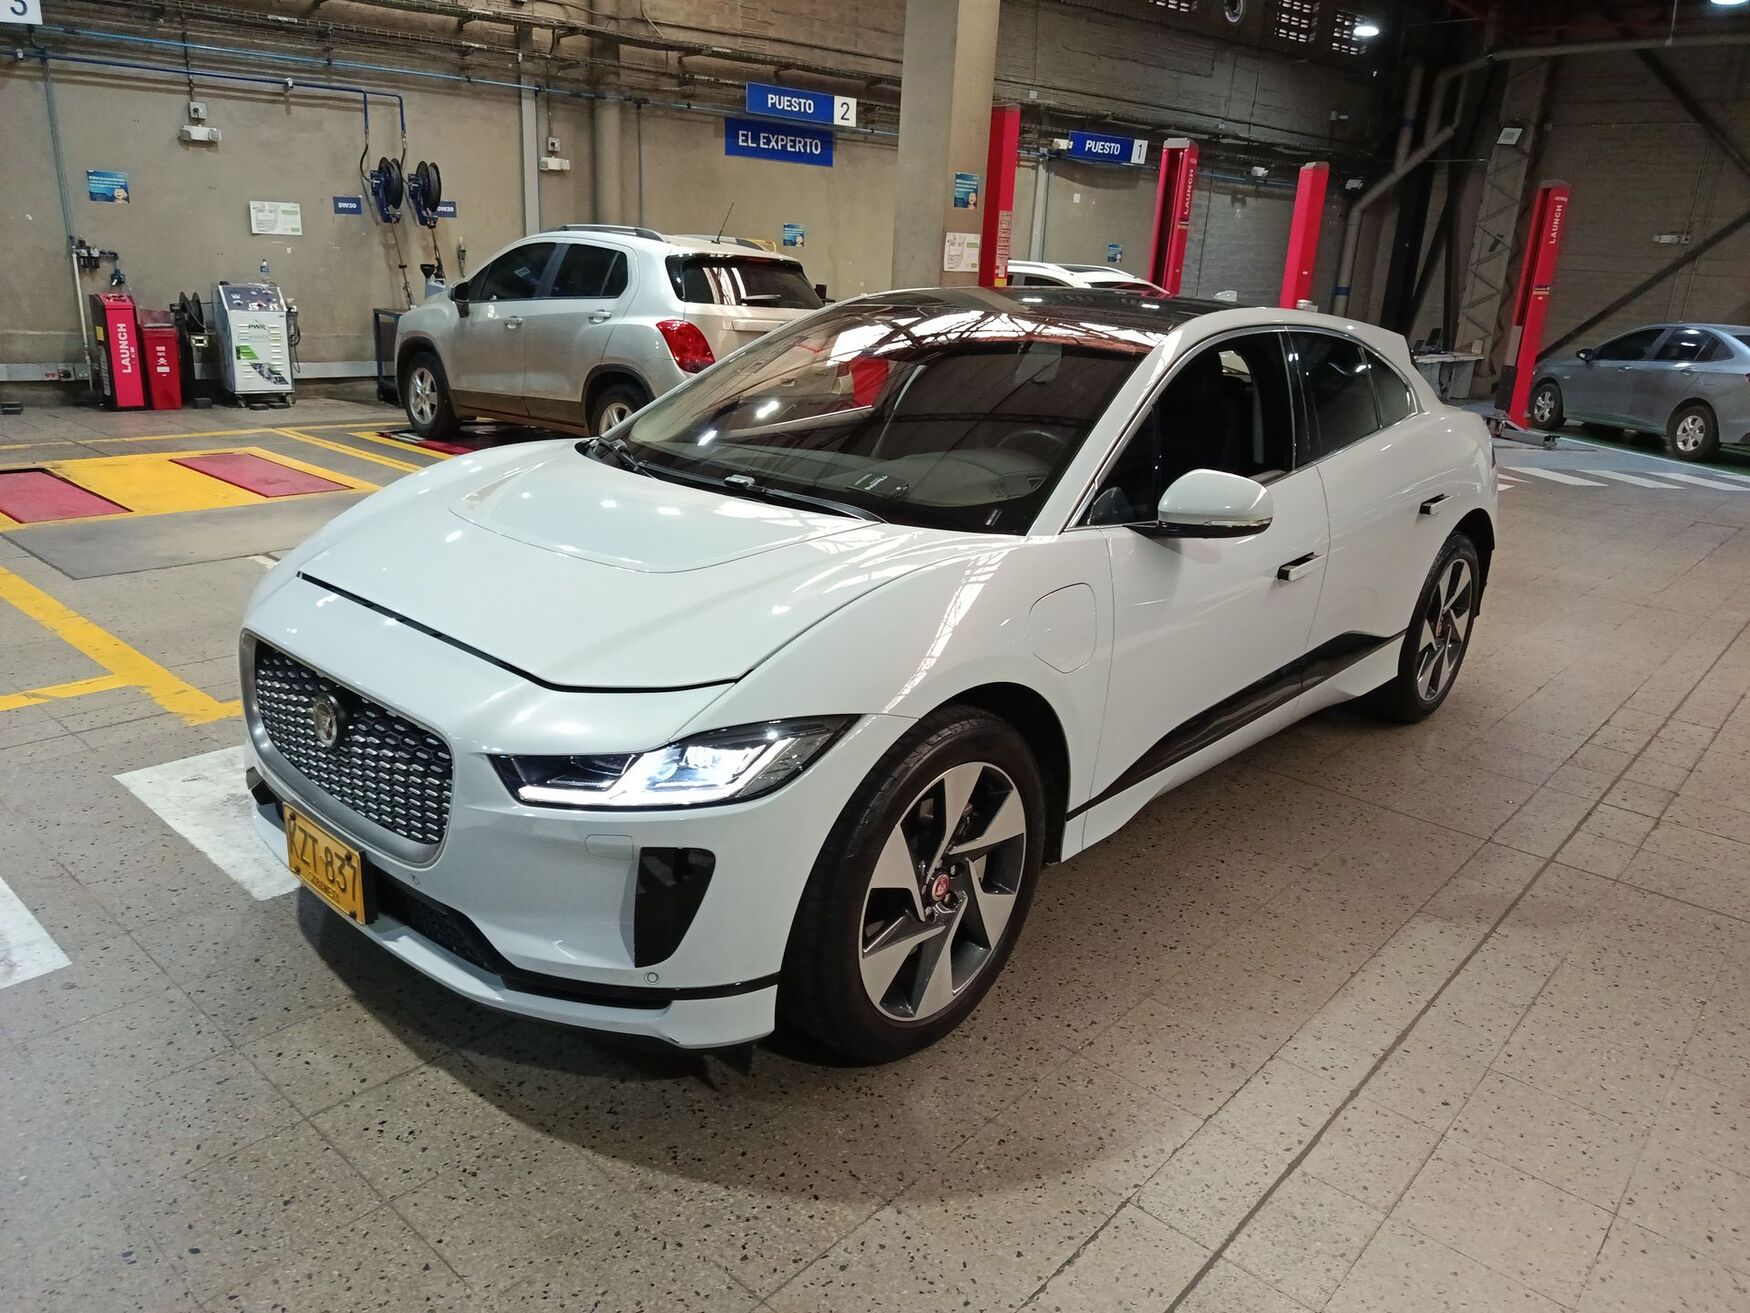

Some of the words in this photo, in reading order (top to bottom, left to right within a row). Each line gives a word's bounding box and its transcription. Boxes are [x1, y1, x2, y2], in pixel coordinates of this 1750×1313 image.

[767, 94, 814, 114] PUESTO
[840, 102, 850, 121] 2
[738, 130, 757, 147] EL
[760, 133, 821, 155] EXPERTO
[1085, 140, 1120, 155] PUESTO
[1138, 144, 1143, 160] 1
[1184, 169, 1194, 215] LAUNCH
[1549, 205, 1563, 244] LAUNCH
[116, 323, 132, 373] LAUNCH
